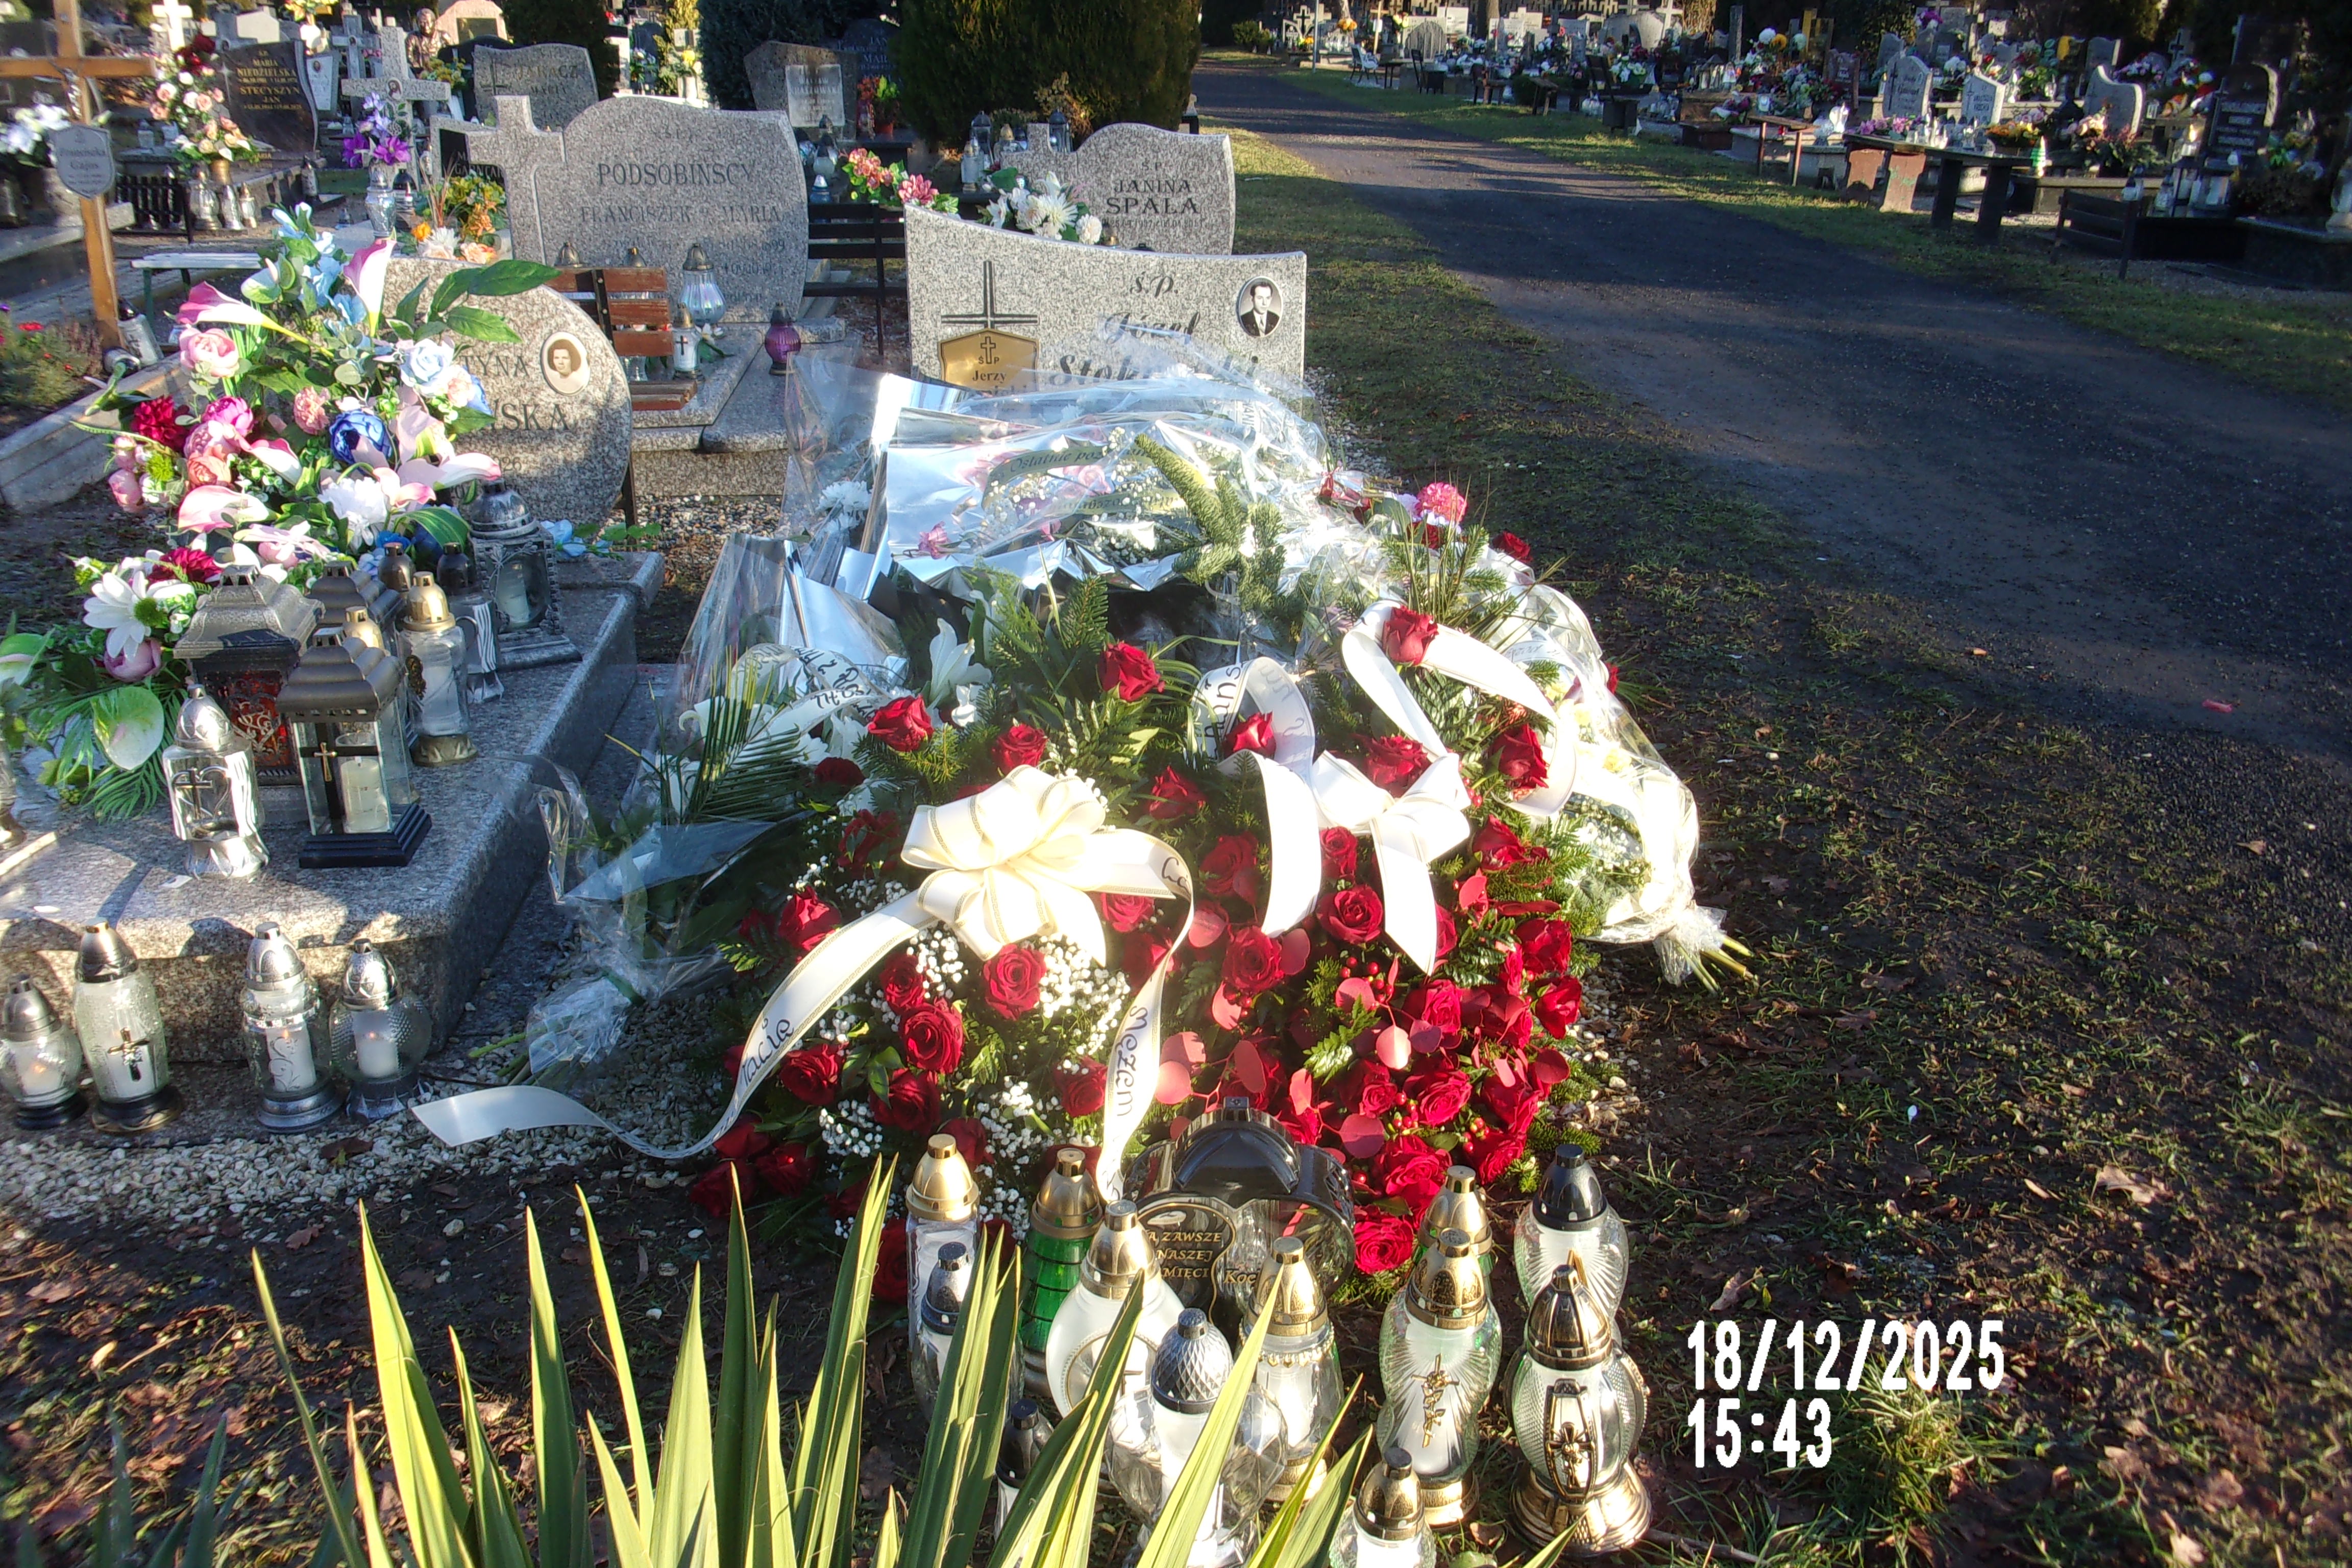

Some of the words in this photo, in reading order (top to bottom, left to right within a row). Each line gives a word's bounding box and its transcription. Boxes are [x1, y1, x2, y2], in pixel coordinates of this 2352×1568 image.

[253, 59, 278, 67] MARIA
[1114, 180, 1192, 193] JANINA
[972, 365, 1006, 383] Jerzy
[1161, 1231, 1222, 1243] ZAWSZE
[1157, 1248, 1213, 1262] NASZEJ
[1161, 1266, 1209, 1280] MIĘCI
